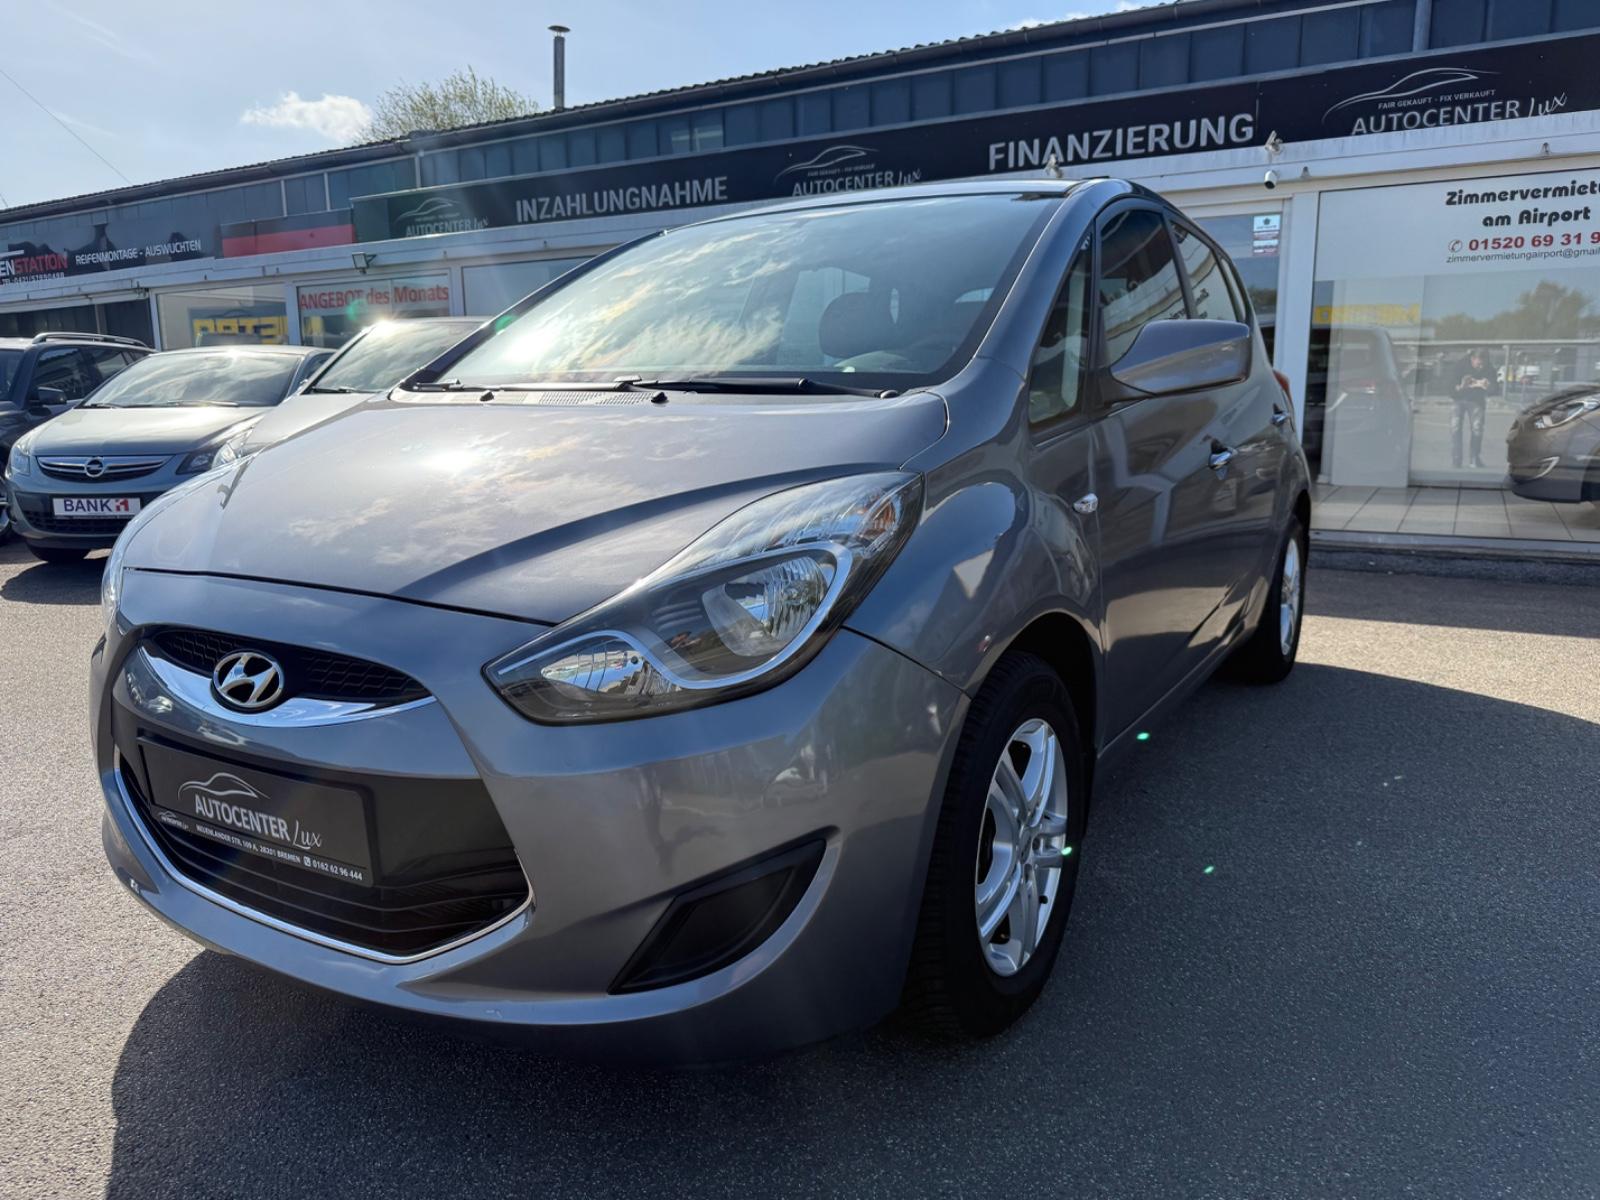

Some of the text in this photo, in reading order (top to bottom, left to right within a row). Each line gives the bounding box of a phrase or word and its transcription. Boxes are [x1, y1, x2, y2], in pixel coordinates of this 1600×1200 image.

[1454, 89, 1496, 100] VERKAUFT
[1351, 99, 1520, 136] AUTOCENTER
[988, 112, 1255, 171] FINANZIERUNG
[792, 170, 894, 197] AUTOCENTER
[515, 176, 728, 223] INZAHLUNGNAHME
[1482, 206, 1591, 227] am Airport
[75, 247, 138, 266] REIFENMONTAGE
[145, 239, 202, 257] AUSWUCHTEN
[1469, 235, 1525, 251] 01520
[1531, 233, 1554, 247] 69
[1560, 232, 1582, 246] 31
[301, 284, 449, 310] ANGEBOT des Monats
[64, 498, 112, 512] BANK
[194, 794, 290, 842] AUTOCENTER
[292, 820, 323, 850] Lux
[312, 859, 329, 872] 0162
